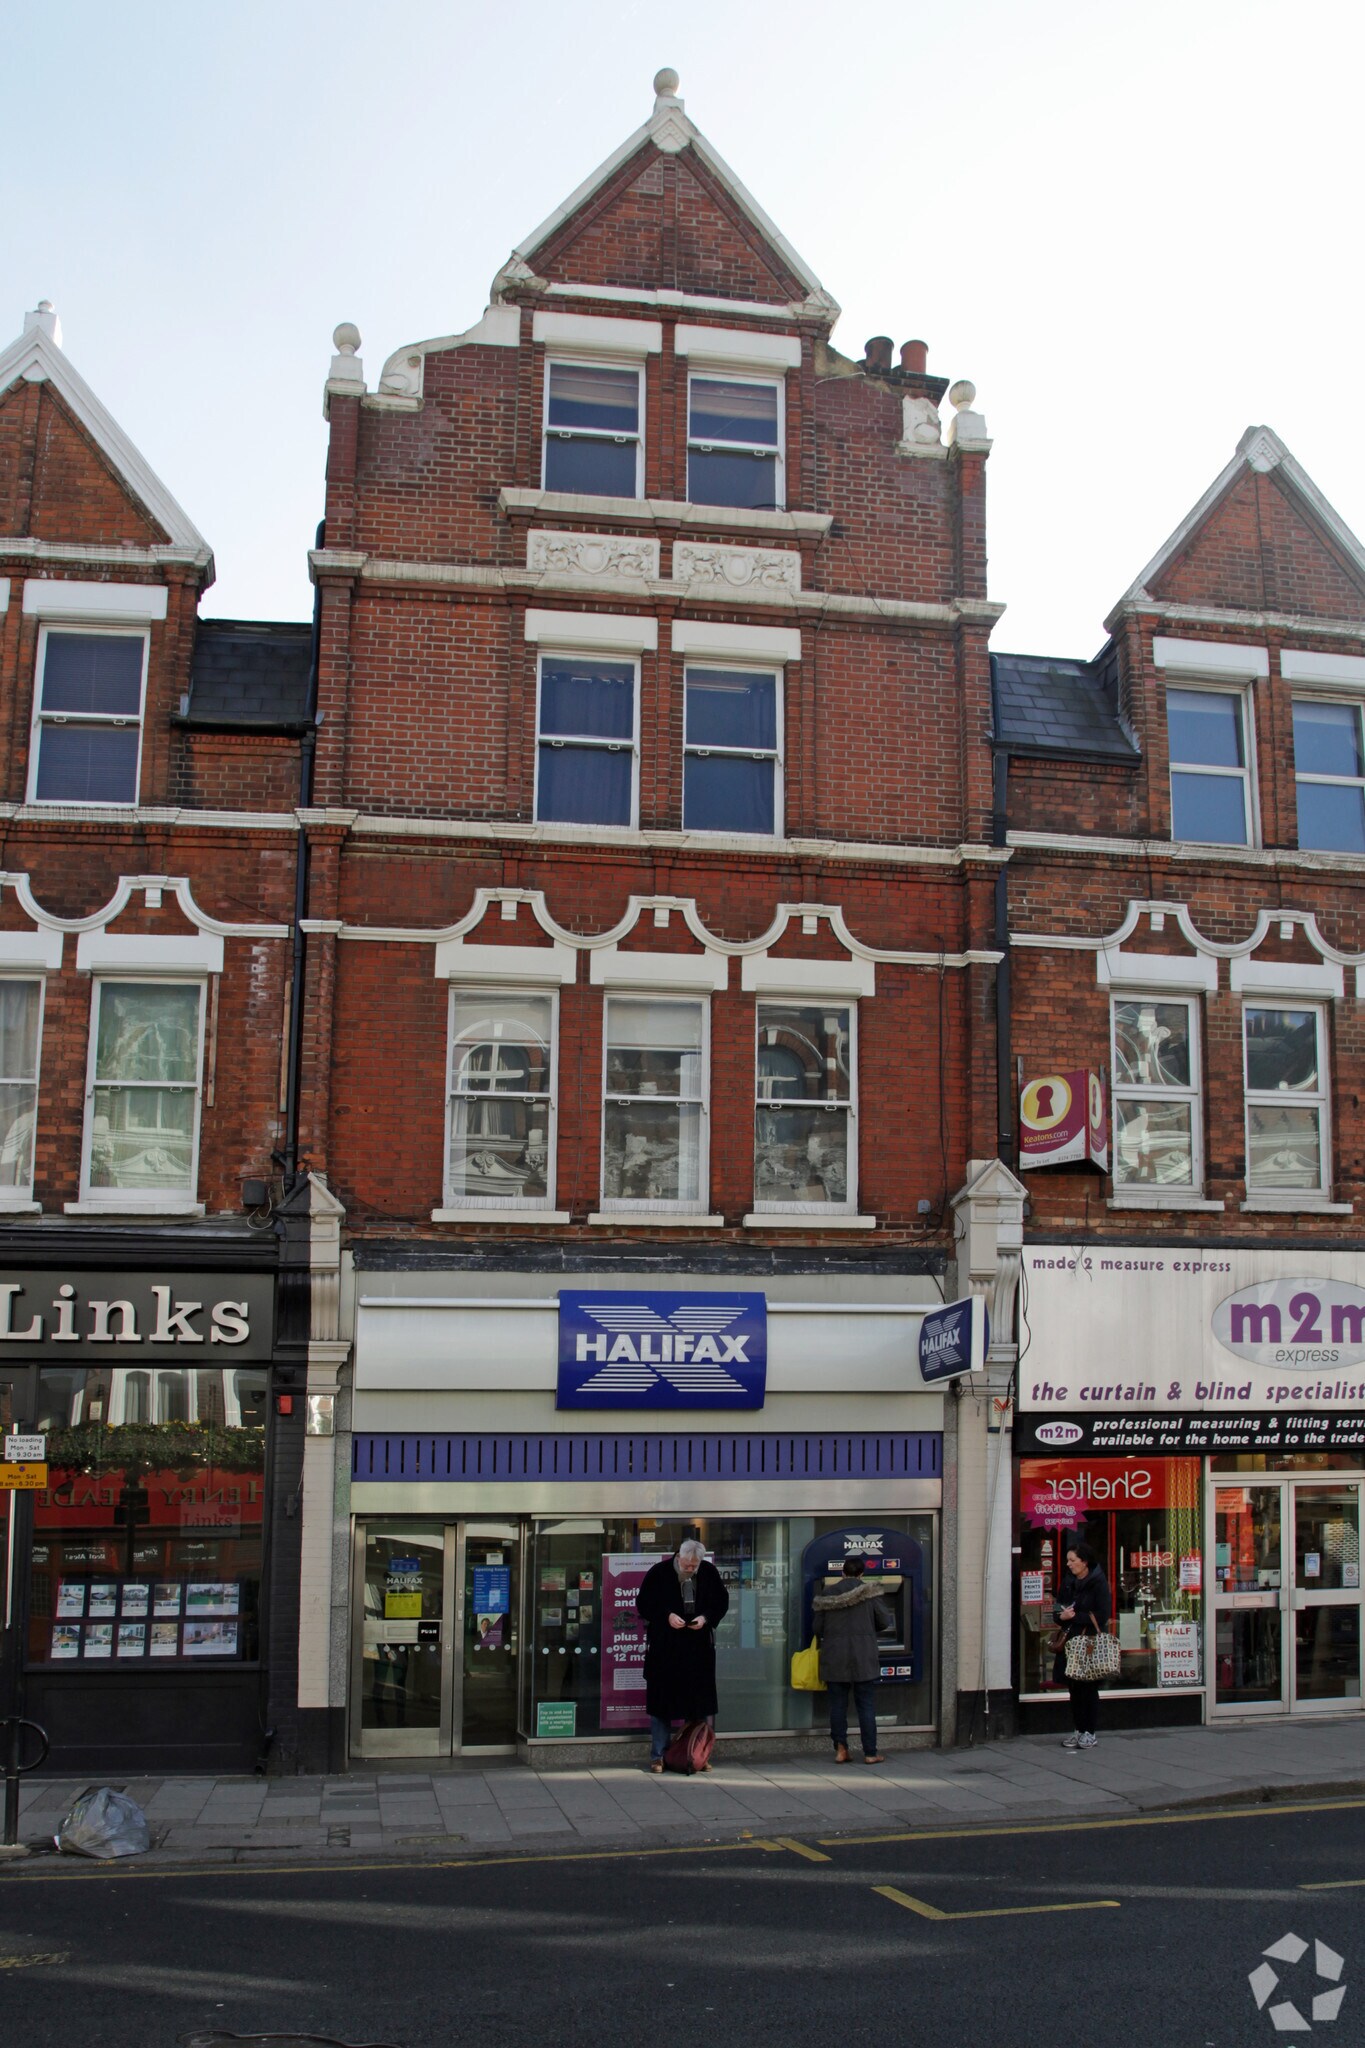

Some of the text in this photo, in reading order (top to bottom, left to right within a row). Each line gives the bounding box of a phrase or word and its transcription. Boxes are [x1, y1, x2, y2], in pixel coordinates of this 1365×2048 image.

[1024, 1130, 1068, 1144] Keatons.com
[1032, 1256, 1231, 1274] made 2 measure express
[0, 1284, 250, 1343] Links
[576, 1333, 751, 1363] HALIFAX
[921, 1327, 961, 1357] HALIFAX
[1275, 1349, 1339, 1365] express
[1031, 1382, 1069, 1401] the
[1079, 1382, 1157, 1401] curtain
[1167, 1381, 1182, 1400] &
[1195, 1381, 1253, 1400] blind
[1092, 1418, 1183, 1432] professional
[1189, 1418, 1261, 1431] measuring
[1268, 1417, 1279, 1429] &
[1286, 1417, 1330, 1431] fitting
[1040, 1425, 1079, 1439] m2m
[1092, 1432, 1365, 1446] available for the home and to the trade
[1034, 1503, 1077, 1515] fitting
[184, 1513, 233, 1528] Links
[844, 1540, 884, 1549] HALIFAX
[614, 1598, 636, 1607] and
[614, 1632, 638, 1643] plus
[1165, 1627, 1191, 1635] HALF
[613, 1653, 627, 1662] 12
[1164, 1650, 1194, 1658] PRICE
[1164, 1669, 1196, 1678] DEALS
